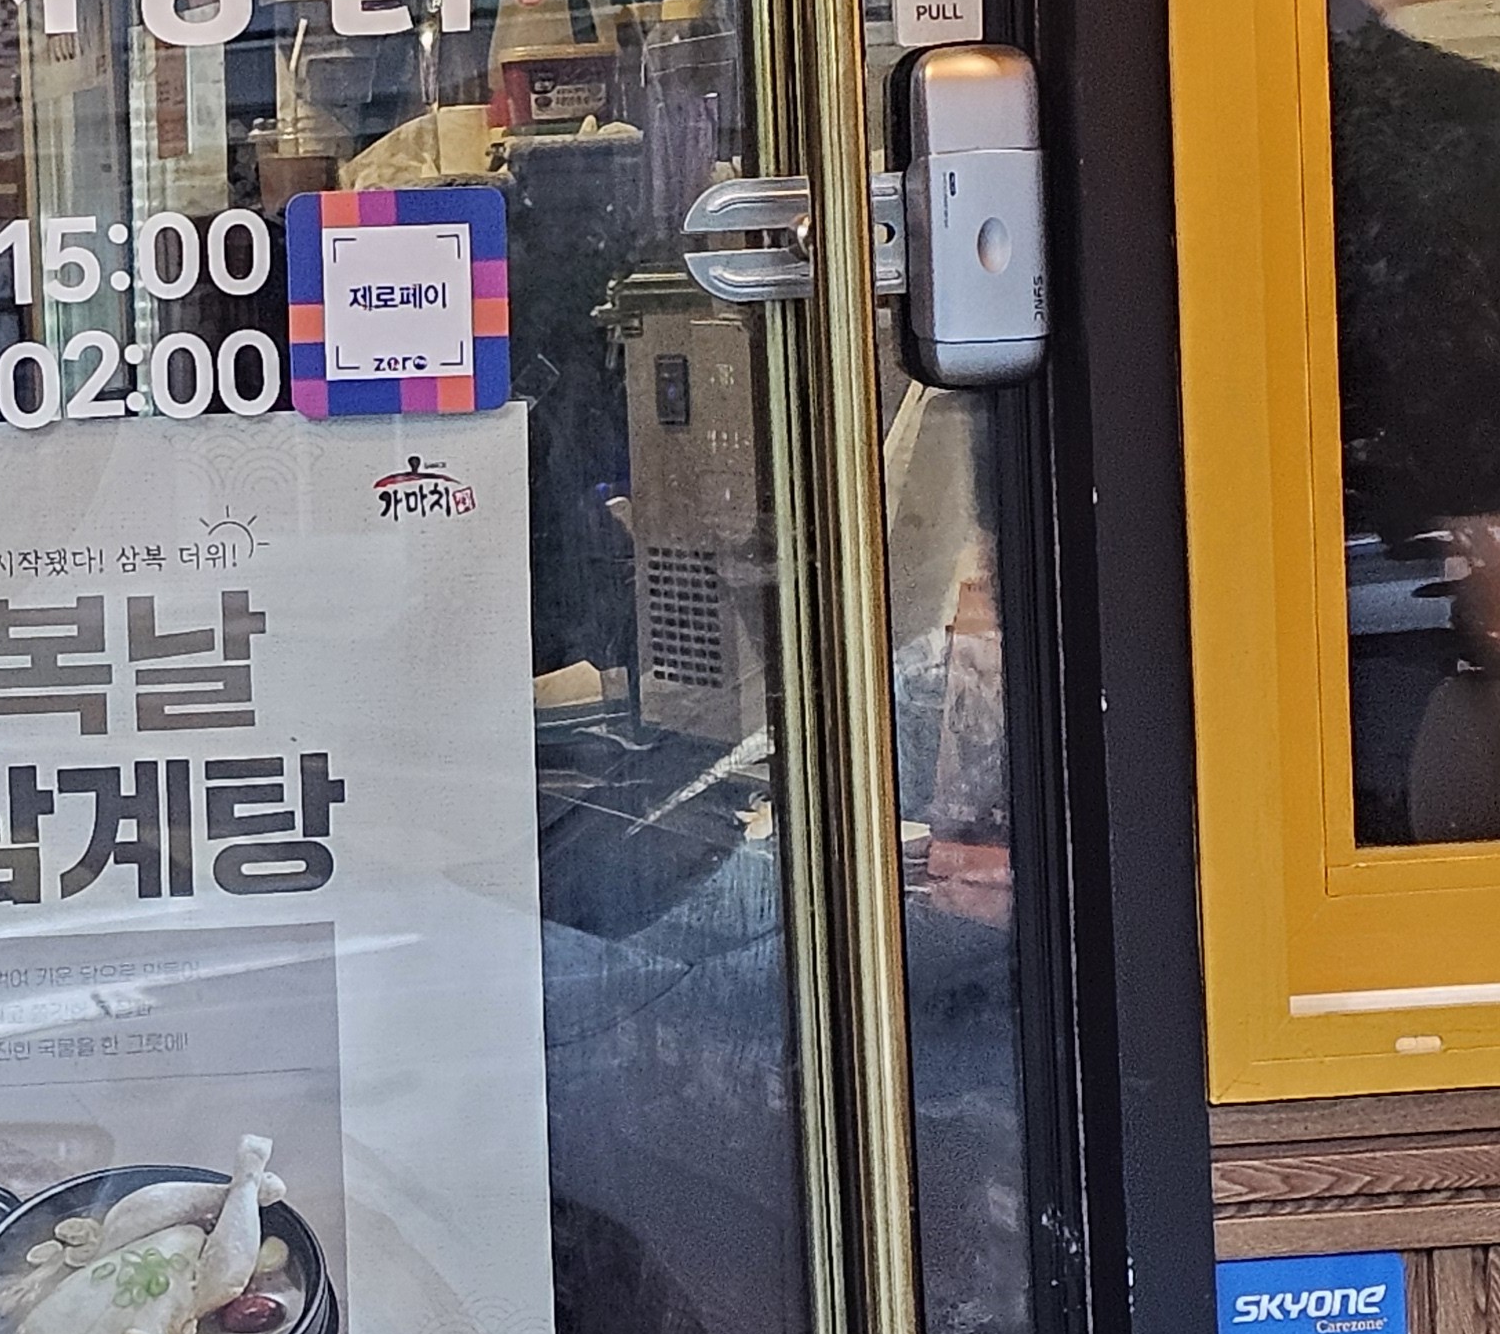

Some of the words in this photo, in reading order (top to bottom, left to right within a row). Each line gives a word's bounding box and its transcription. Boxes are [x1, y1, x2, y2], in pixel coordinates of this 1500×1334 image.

[916, 3, 963, 21] PULL
[348, 281, 448, 312] 제로페이
[1033, 274, 1045, 322] SYNC
[378, 482, 452, 522] 가마치
[116, 544, 167, 573] 삼복
[178, 541, 238, 569] 더위!
[37, 1036, 94, 1058] 국물을
[101, 1034, 119, 1055] 한
[126, 1031, 189, 1055] 그릇에!
[1316, 1317, 1385, 1334] Carezone
